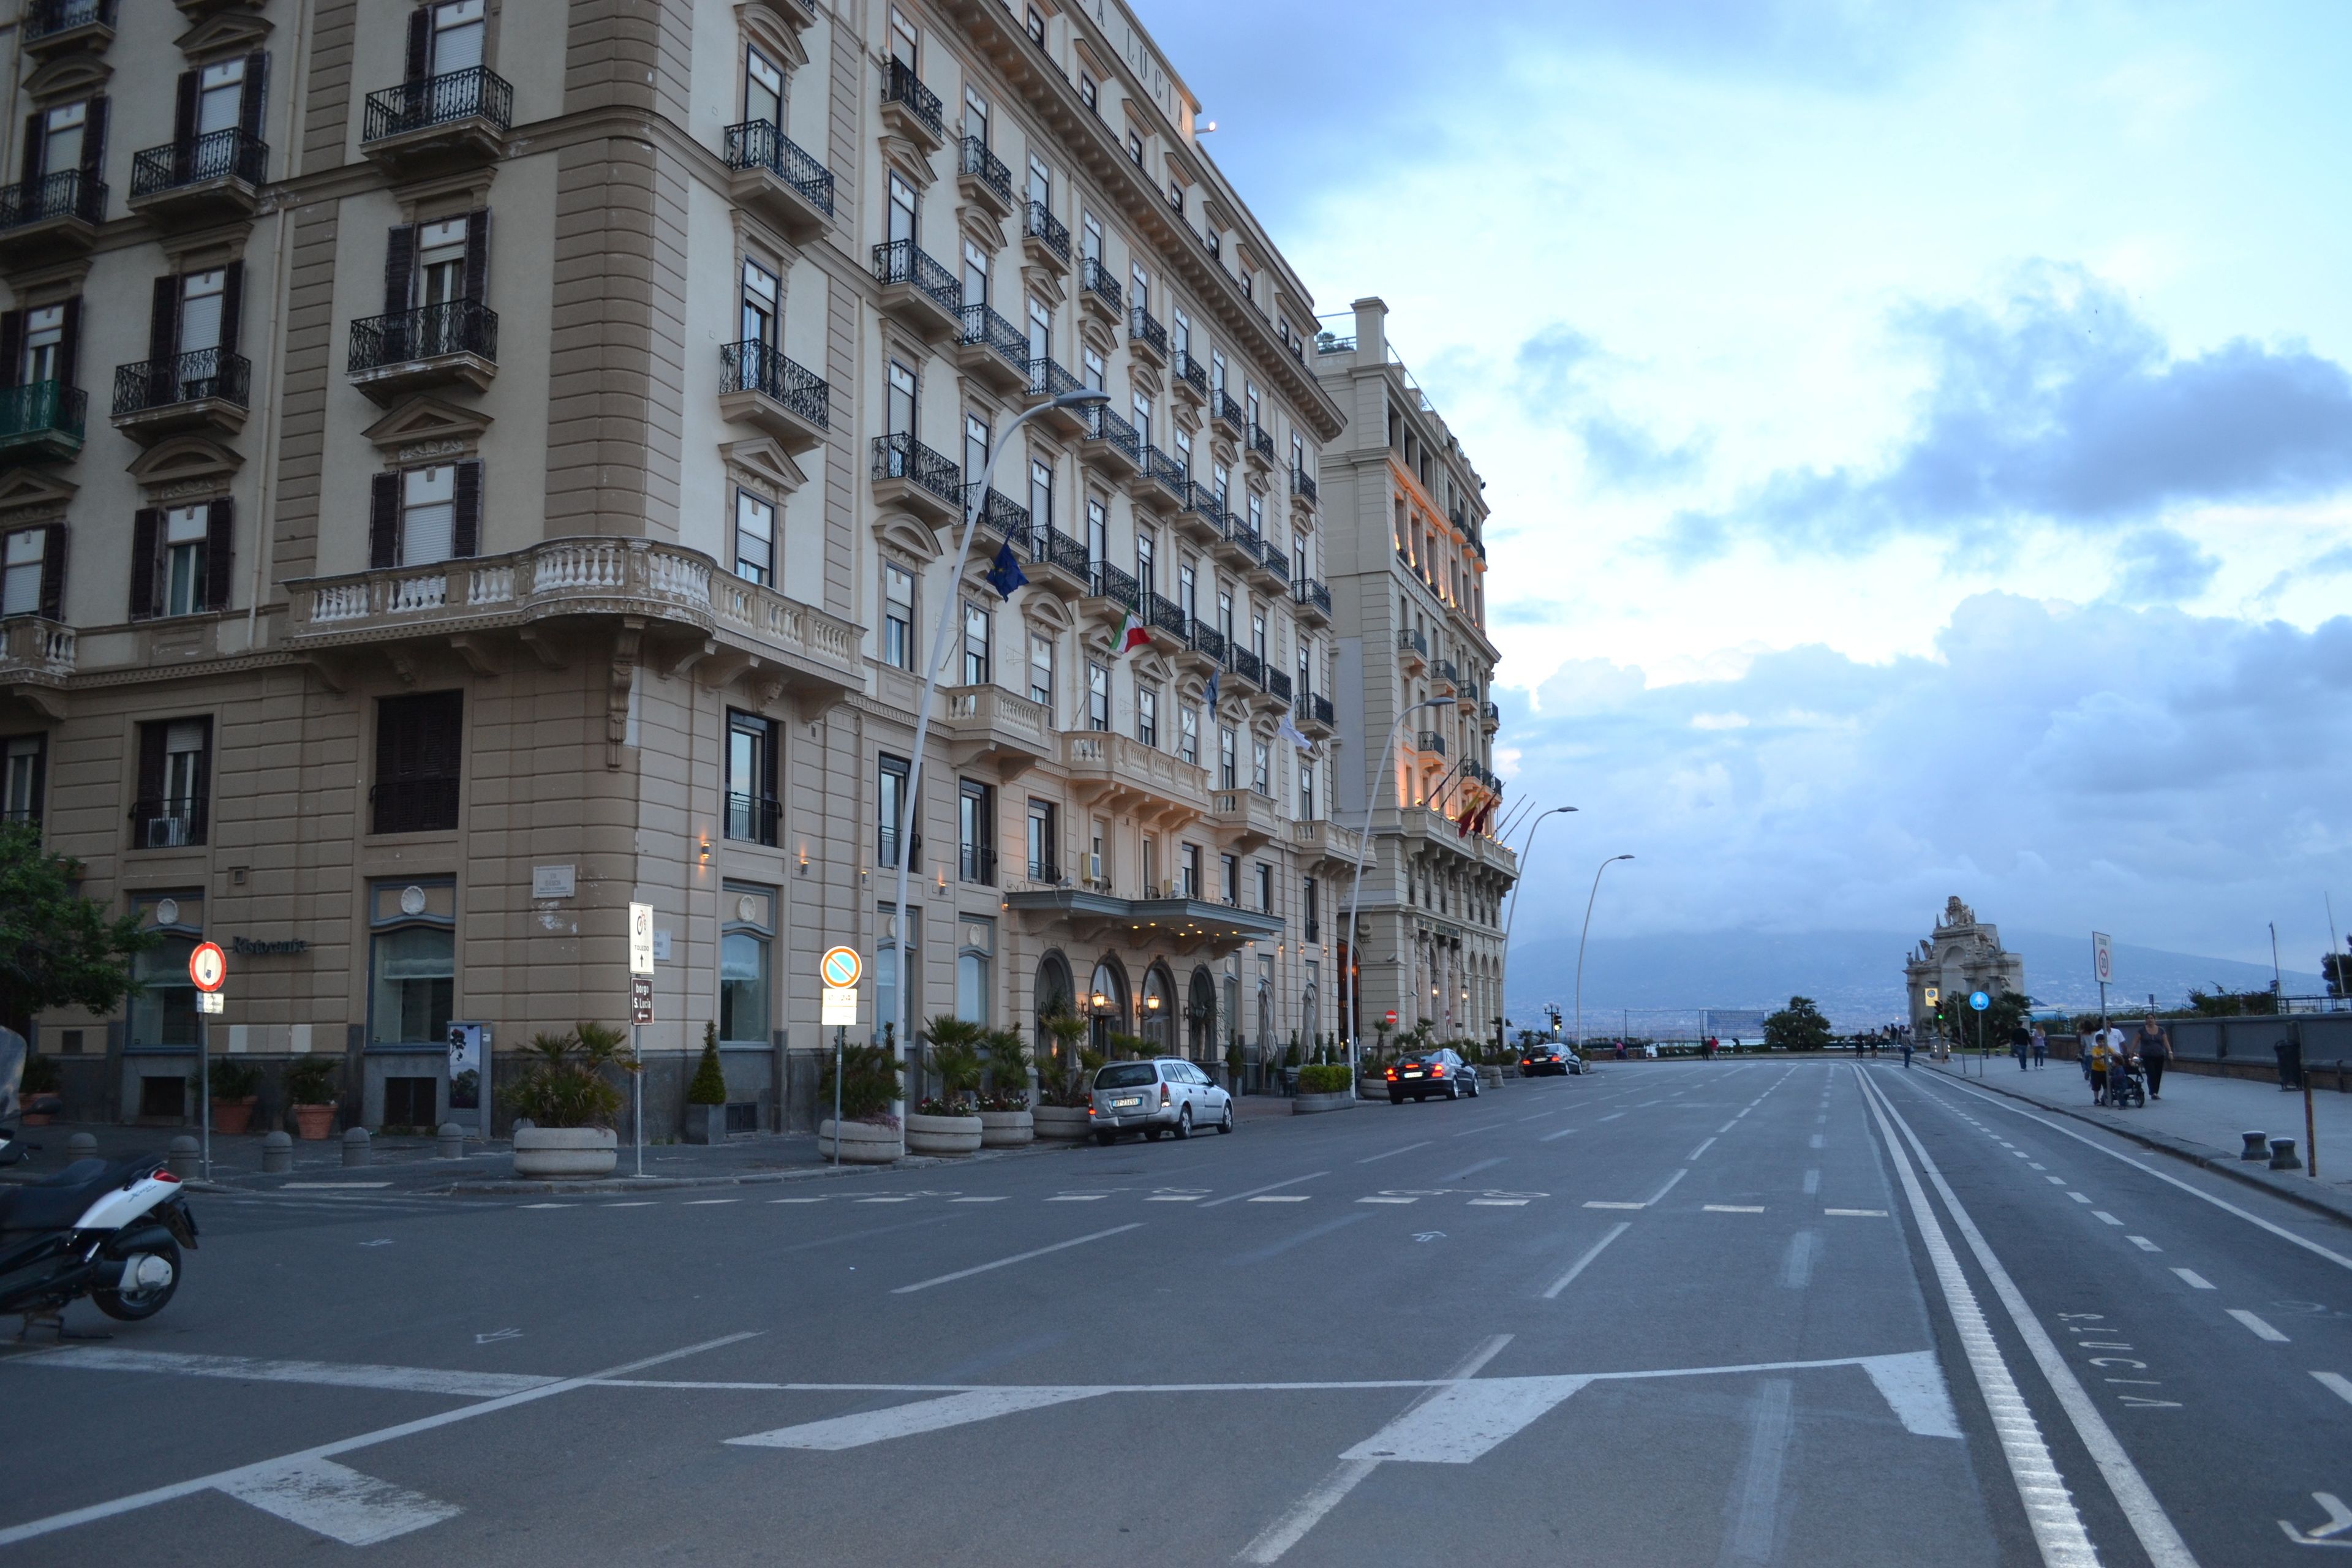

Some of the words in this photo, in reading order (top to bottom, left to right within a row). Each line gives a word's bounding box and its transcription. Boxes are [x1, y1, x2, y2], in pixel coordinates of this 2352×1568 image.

[1127, 28, 1185, 132] LUCIA
[1401, 569, 1441, 619] EXCELSIOR
[233, 937, 307, 954] Ristorante
[2101, 957, 2106, 969] 30
[636, 983, 649, 996] borgo
[639, 998, 651, 1009] Lucia
